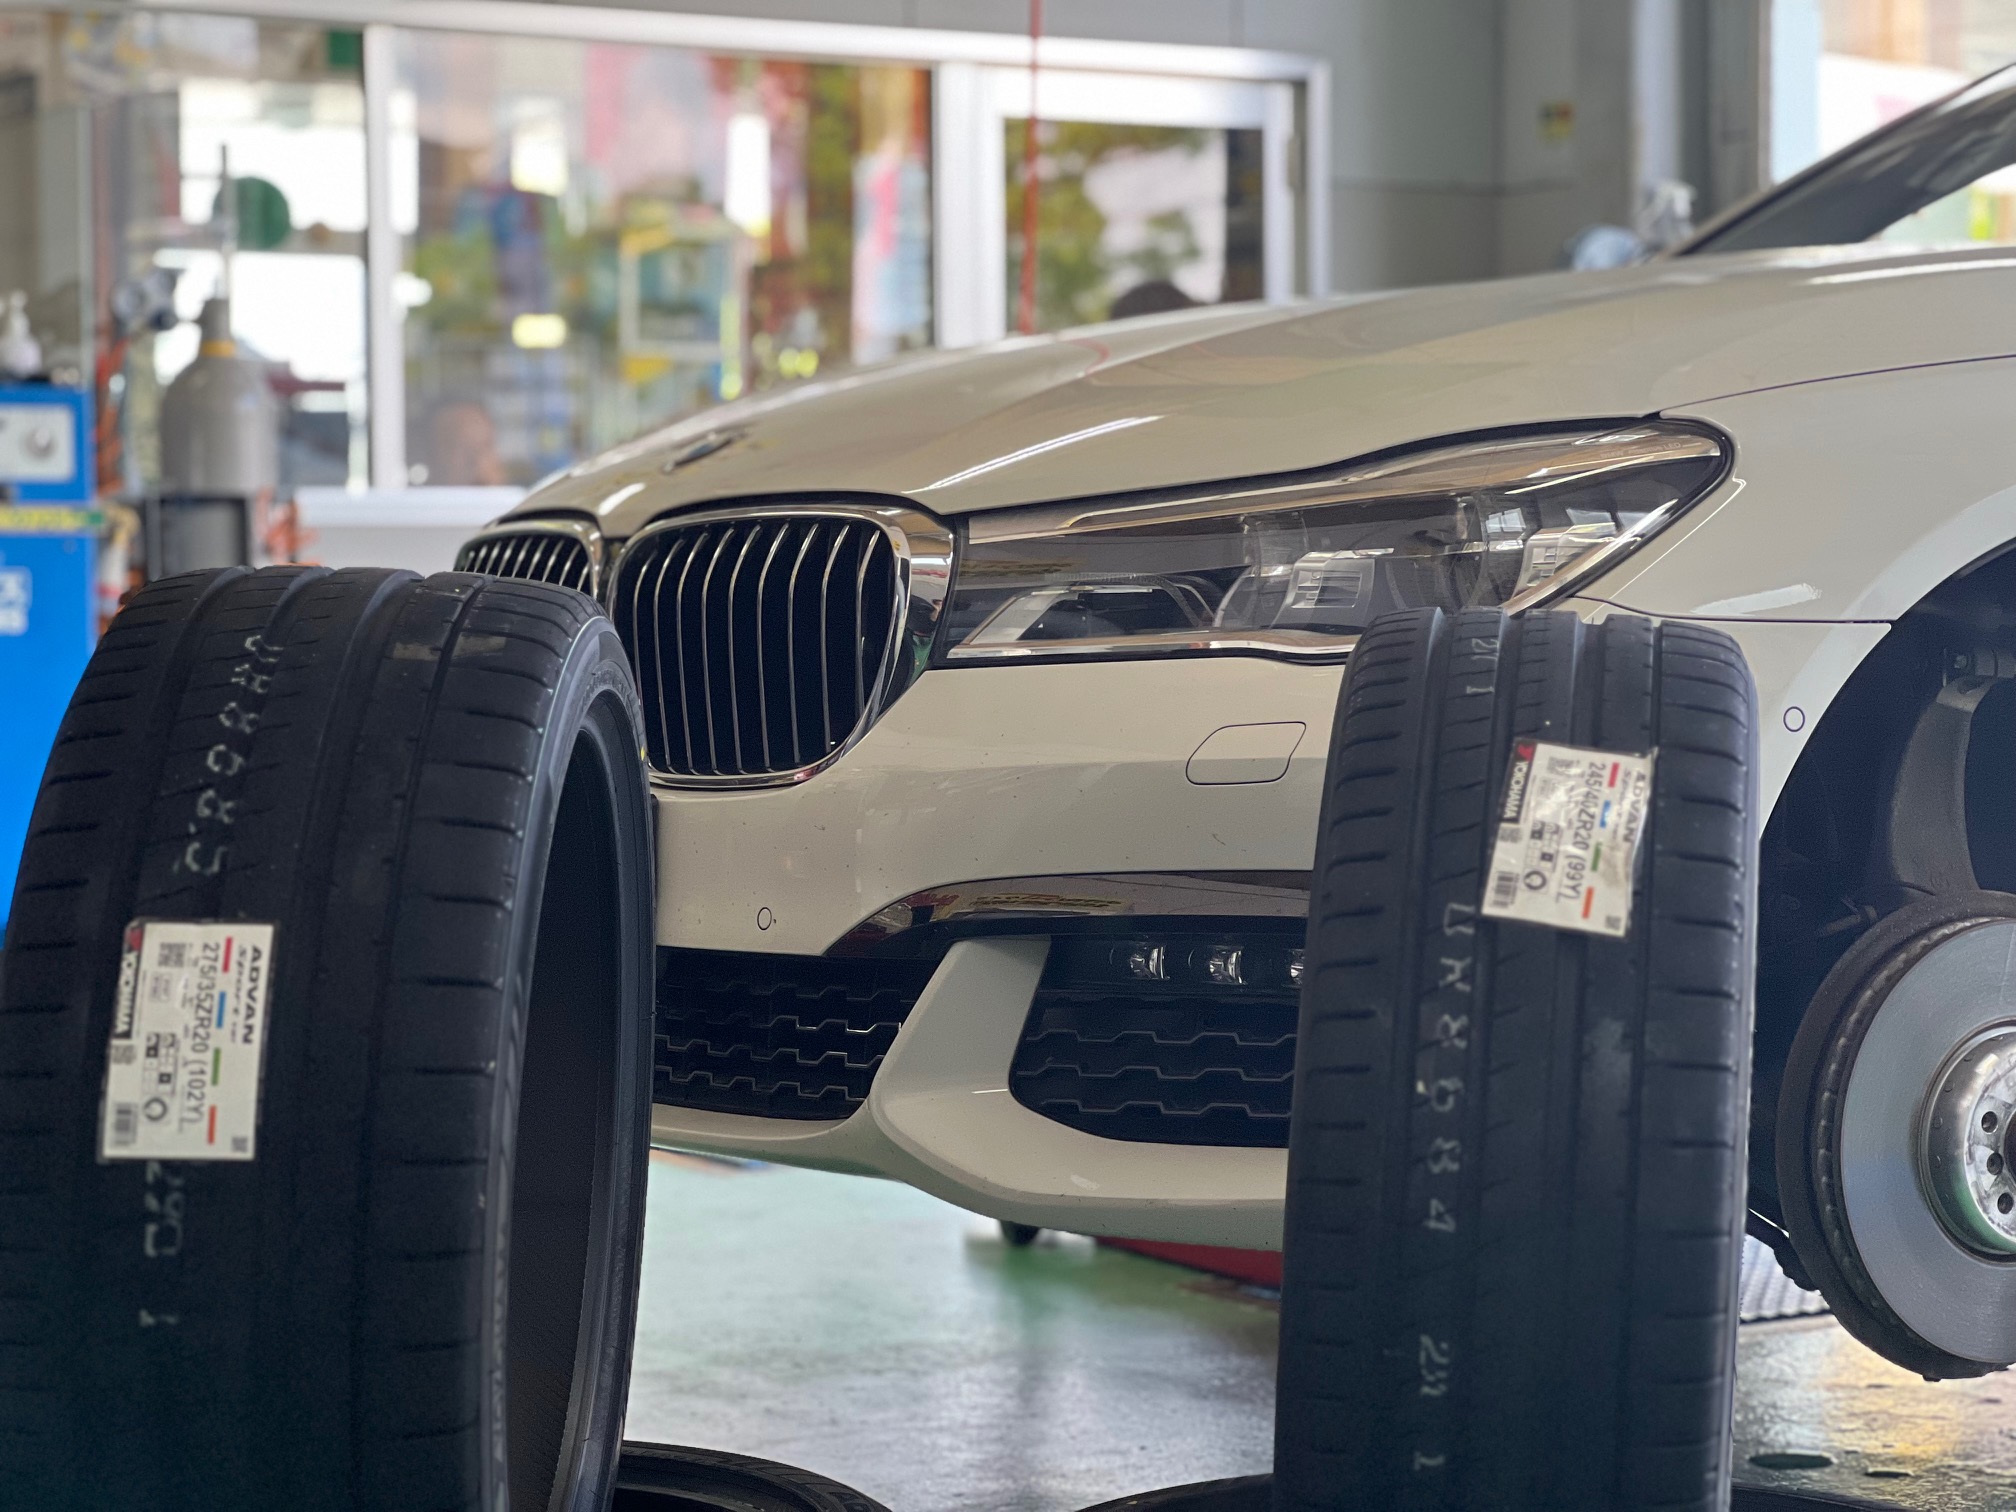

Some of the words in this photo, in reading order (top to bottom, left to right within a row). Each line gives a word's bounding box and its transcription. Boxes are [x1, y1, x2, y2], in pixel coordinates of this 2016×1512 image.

[1663, 441, 1682, 450] LED
[1503, 761, 1529, 819] YOKOHAMA
[1572, 761, 1606, 850] 245/40ZR20
[1622, 770, 1647, 843] ADVAN
[1557, 854, 1586, 901] (99Y)
[190, 942, 220, 1054] 275/35ZR20
[231, 944, 248, 1017] Sport
[242, 945, 264, 1045] ADVAN
[182, 1059, 209, 1125] (102Y)
